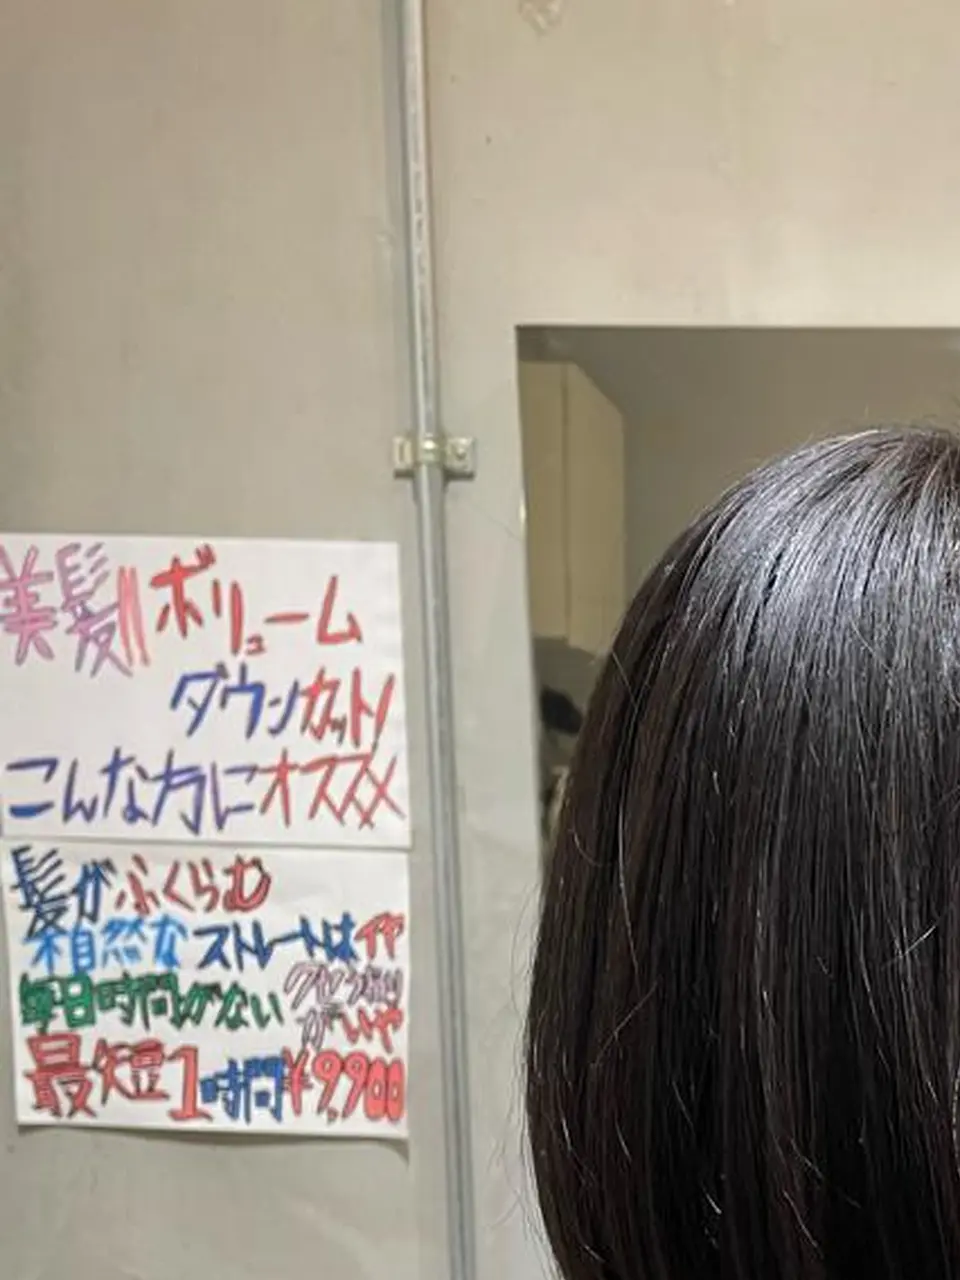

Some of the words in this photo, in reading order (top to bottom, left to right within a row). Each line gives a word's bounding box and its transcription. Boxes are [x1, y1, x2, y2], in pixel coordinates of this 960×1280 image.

[6, 747, 406, 836] こんな方にオススメ
[11, 845, 273, 939] 髪がふくらむ
